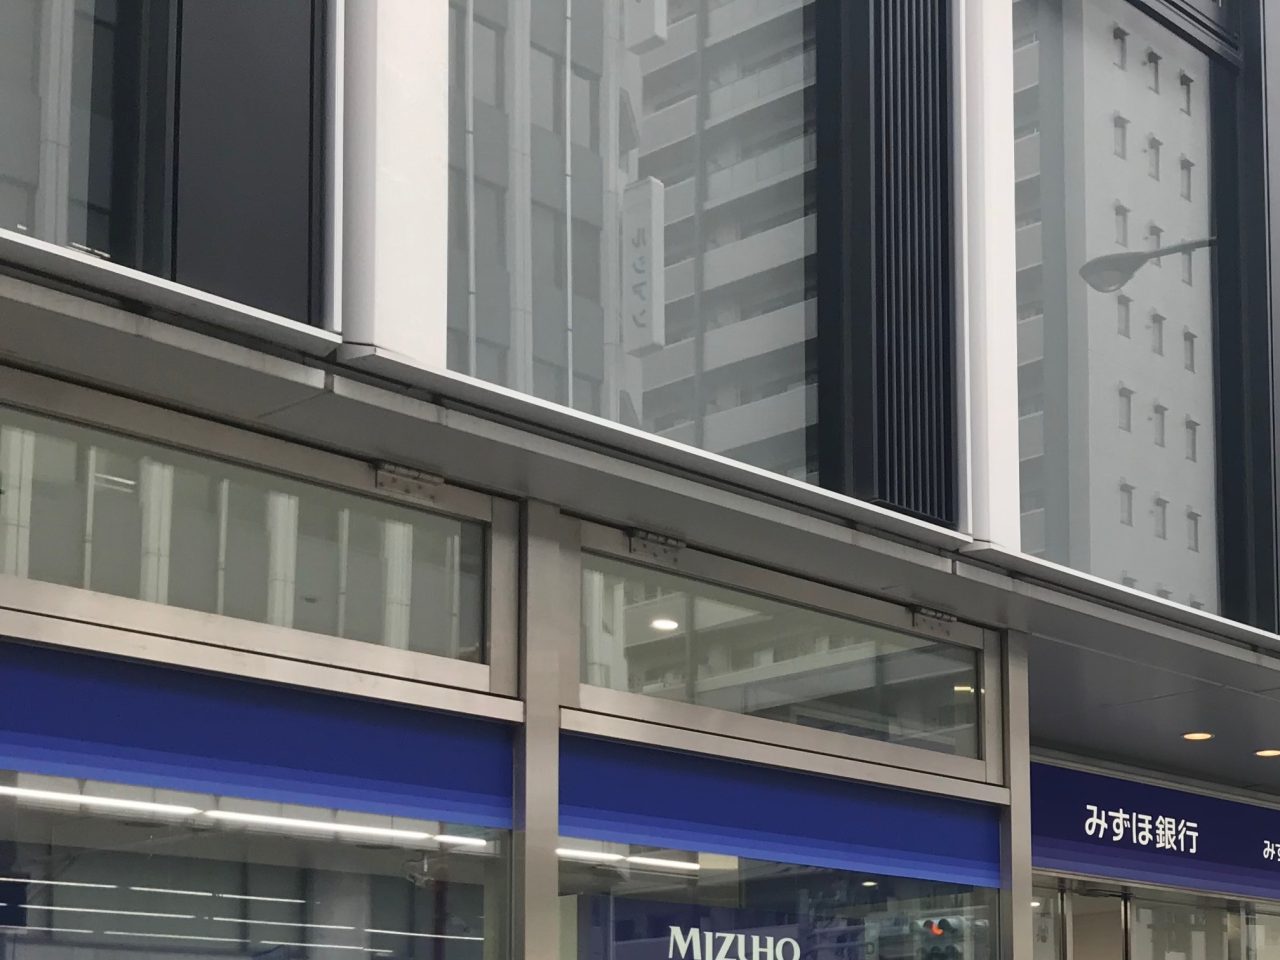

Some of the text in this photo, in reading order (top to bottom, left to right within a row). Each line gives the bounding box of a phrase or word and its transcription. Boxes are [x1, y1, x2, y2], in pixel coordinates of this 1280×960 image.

[1084, 804, 1199, 853] みずほ銀行
